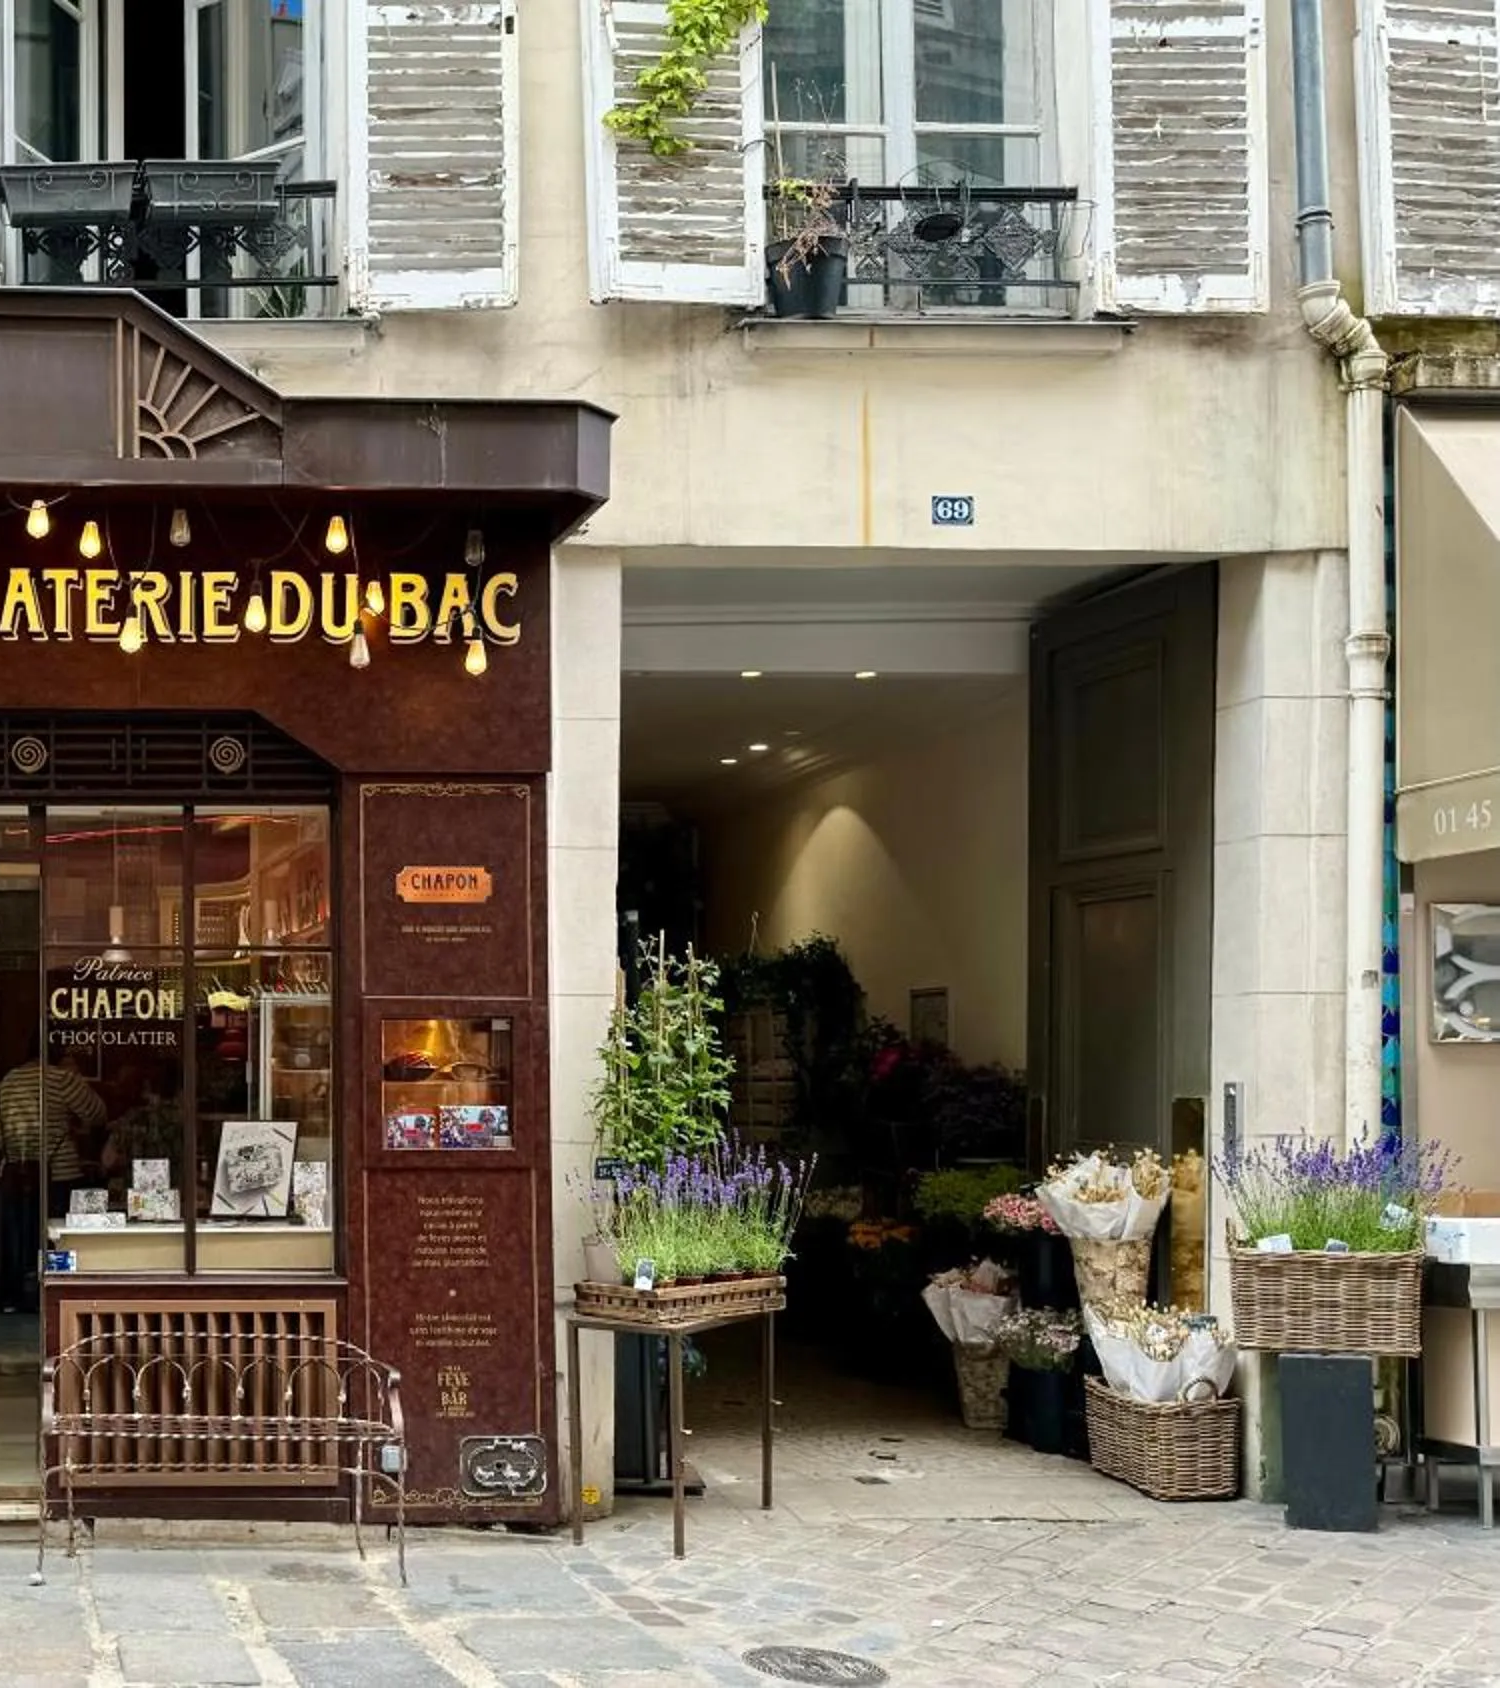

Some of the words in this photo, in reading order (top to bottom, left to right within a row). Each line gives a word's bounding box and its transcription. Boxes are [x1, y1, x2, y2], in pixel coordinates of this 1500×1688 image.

[936, 499, 969, 519] 69
[269, 571, 358, 644] DU
[388, 572, 521, 645] BAC
[1434, 807, 1457, 835] 01
[1465, 799, 1492, 830] 45
[411, 873, 479, 891] CHAPON
[73, 955, 153, 981] Patrice
[50, 987, 176, 1019] CHAPON
[48, 1030, 177, 1046] CHOCOLATIER
